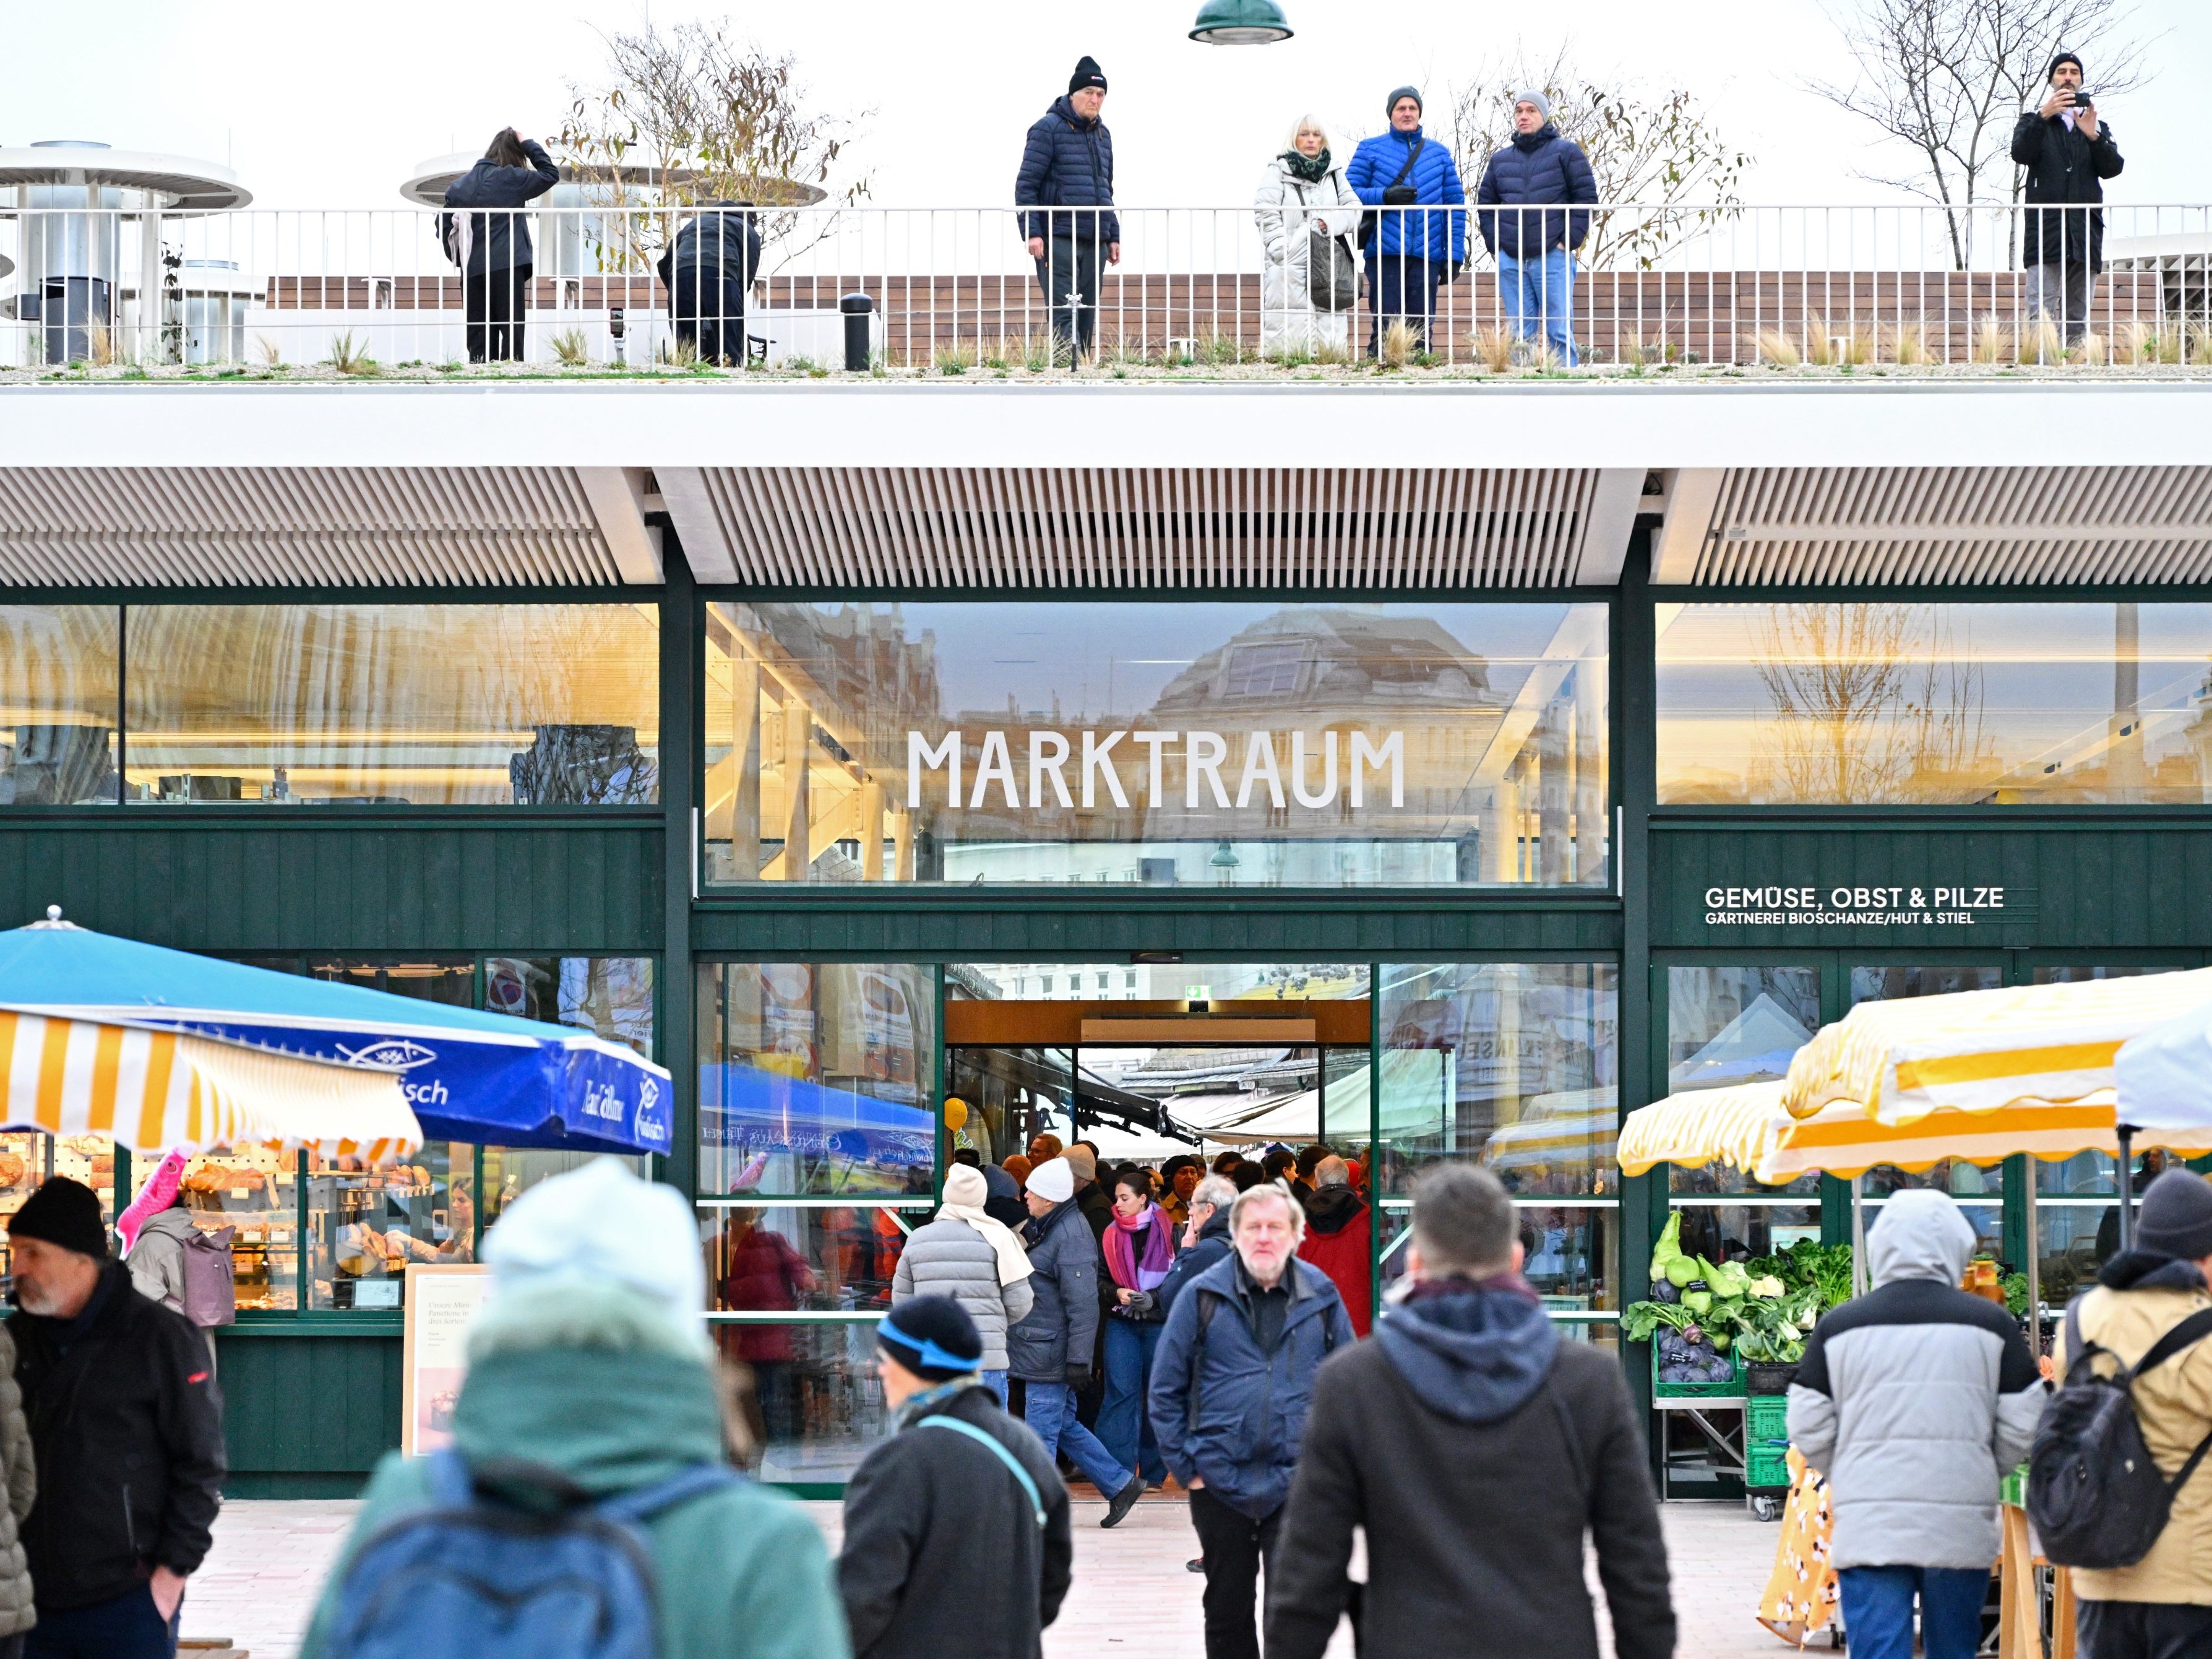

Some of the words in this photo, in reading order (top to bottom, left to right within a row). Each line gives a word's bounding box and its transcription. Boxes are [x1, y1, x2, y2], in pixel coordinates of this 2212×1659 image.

[907, 731, 1404, 808] MARKTRAUM
[1705, 886, 1823, 911] GEMÜSE,
[1831, 887, 1902, 908] OBST
[1909, 887, 1926, 908] &
[1934, 887, 2003, 908] PILZE
[1705, 911, 1785, 924] GÄRTNEREI
[1788, 912, 1919, 926] BIOSCHANZE/HUT
[1922, 912, 1932, 924] &
[1936, 912, 1974, 924] STIEL
[400, 1077, 449, 1105] isch
